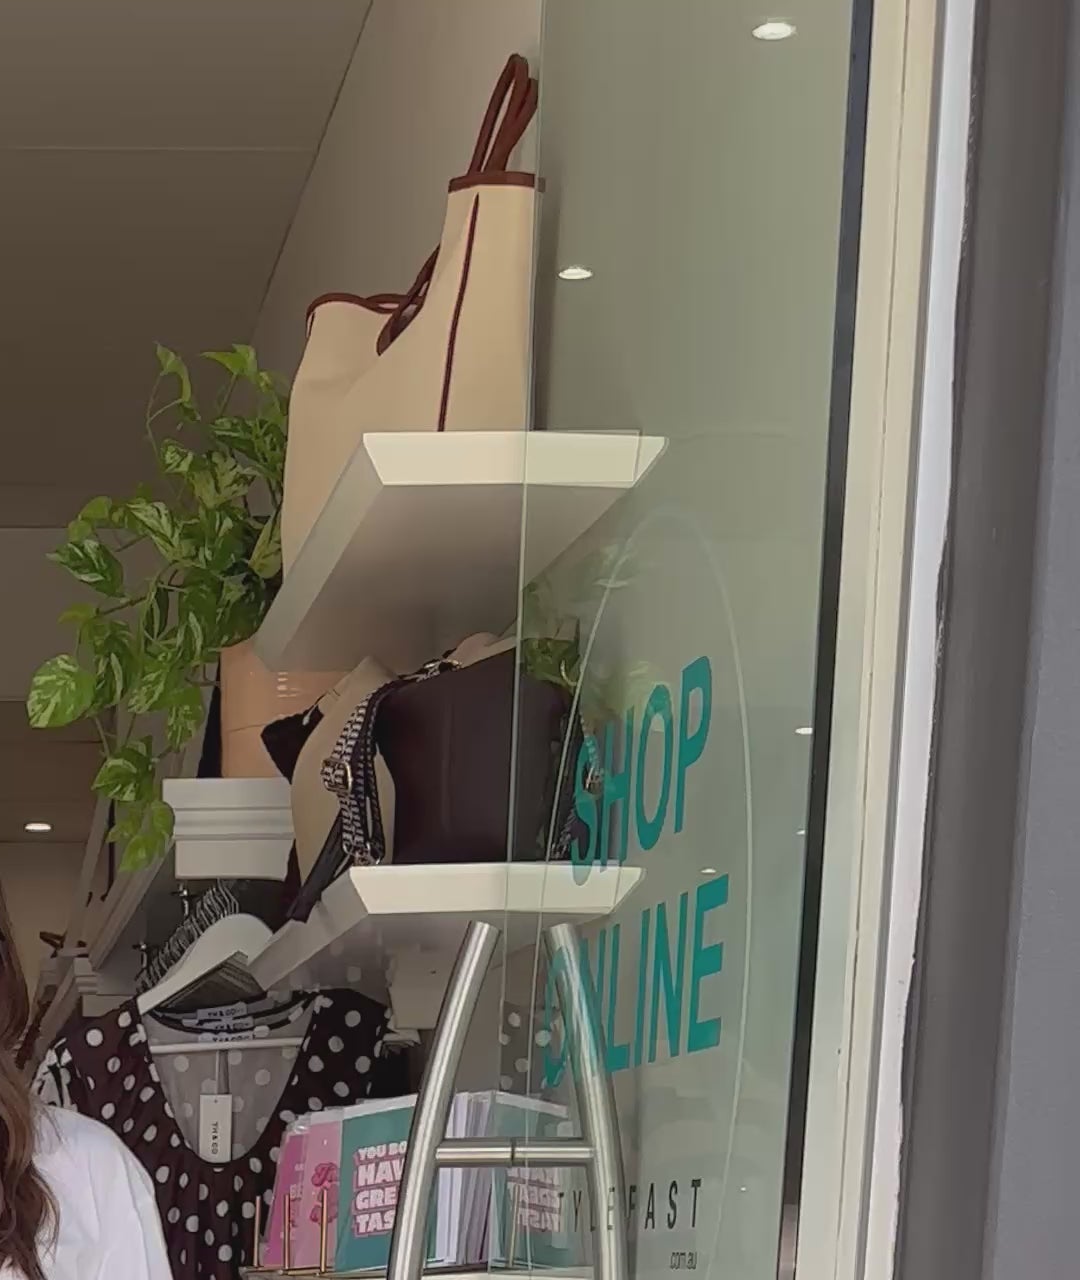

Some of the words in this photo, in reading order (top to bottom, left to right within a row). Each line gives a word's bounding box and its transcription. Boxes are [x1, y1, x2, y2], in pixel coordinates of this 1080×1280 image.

[570, 655, 712, 886] SHOP
[542, 873, 729, 1089] ONLINE
[358, 1143, 387, 1161] YOU
[358, 1158, 405, 1187] HAV
[356, 1186, 397, 1210] GRE
[538, 1178, 702, 1233] TYLEFAST
[356, 1209, 396, 1233] TAS
